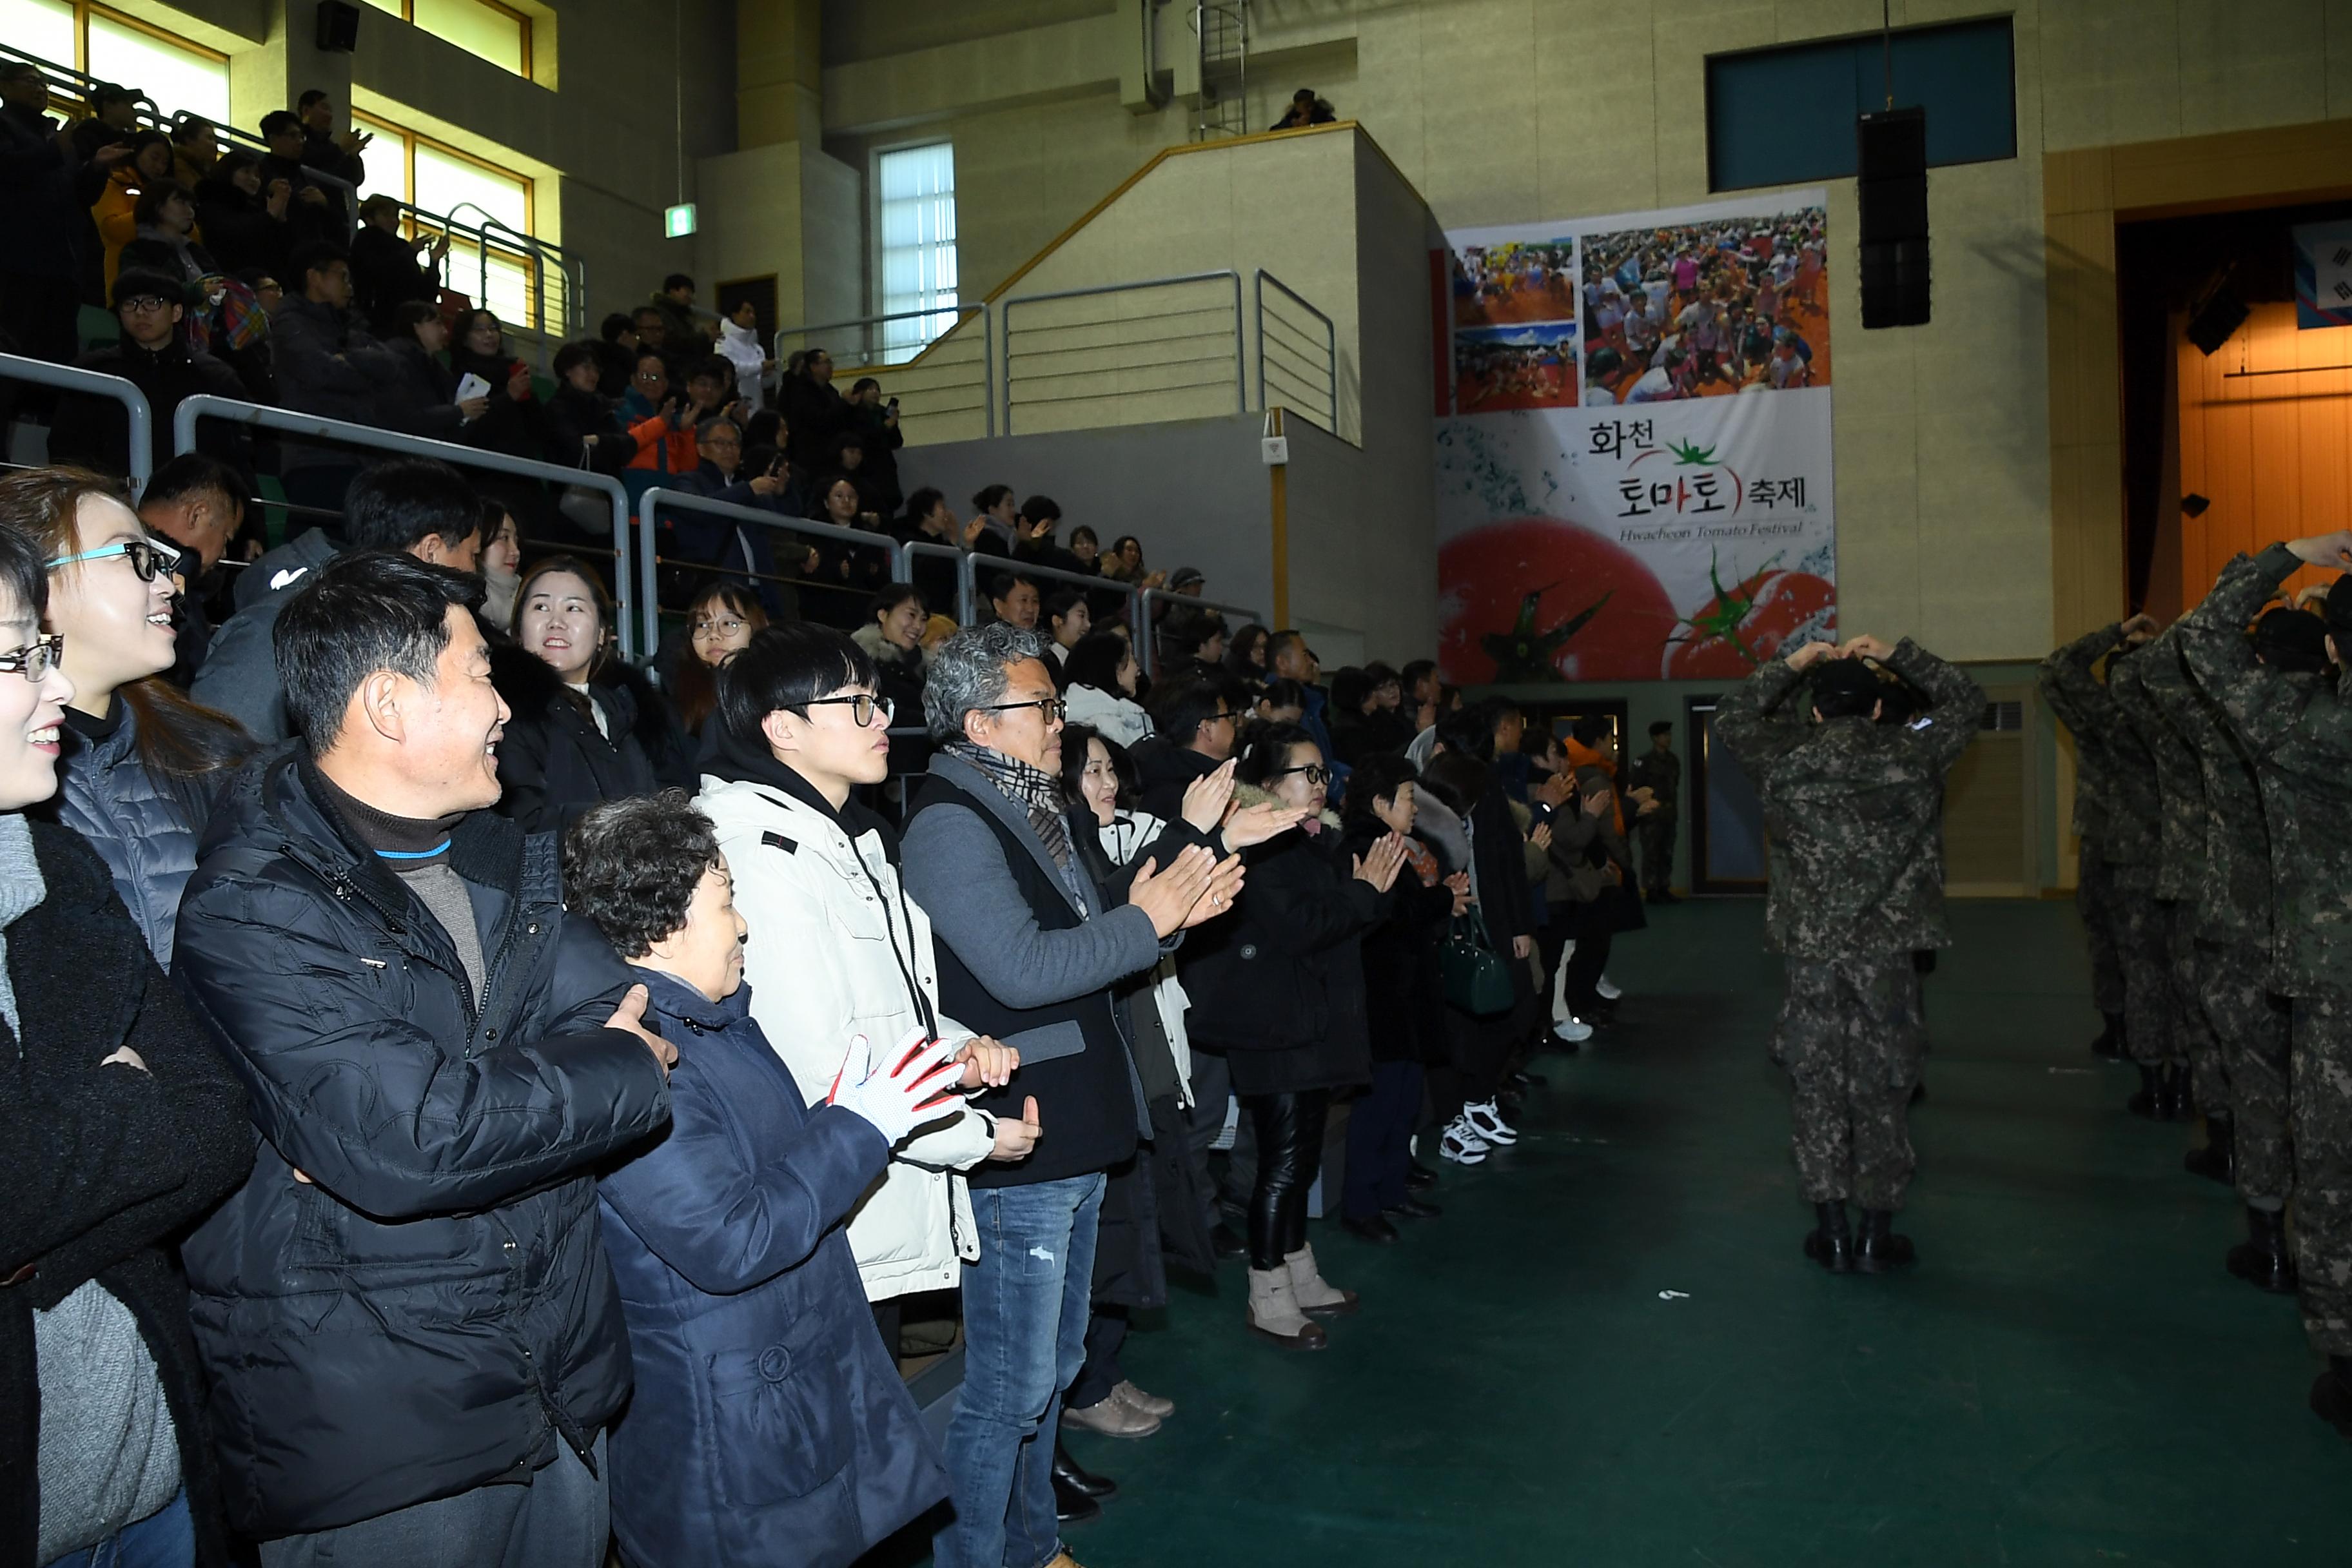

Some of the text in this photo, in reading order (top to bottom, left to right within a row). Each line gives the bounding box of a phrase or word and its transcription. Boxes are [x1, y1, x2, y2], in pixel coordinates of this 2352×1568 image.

[1588, 419, 1654, 460] 화천
[1617, 473, 1806, 517] 토마토 축제
[1619, 521, 1803, 542] Hwacheon Tomato Festival
